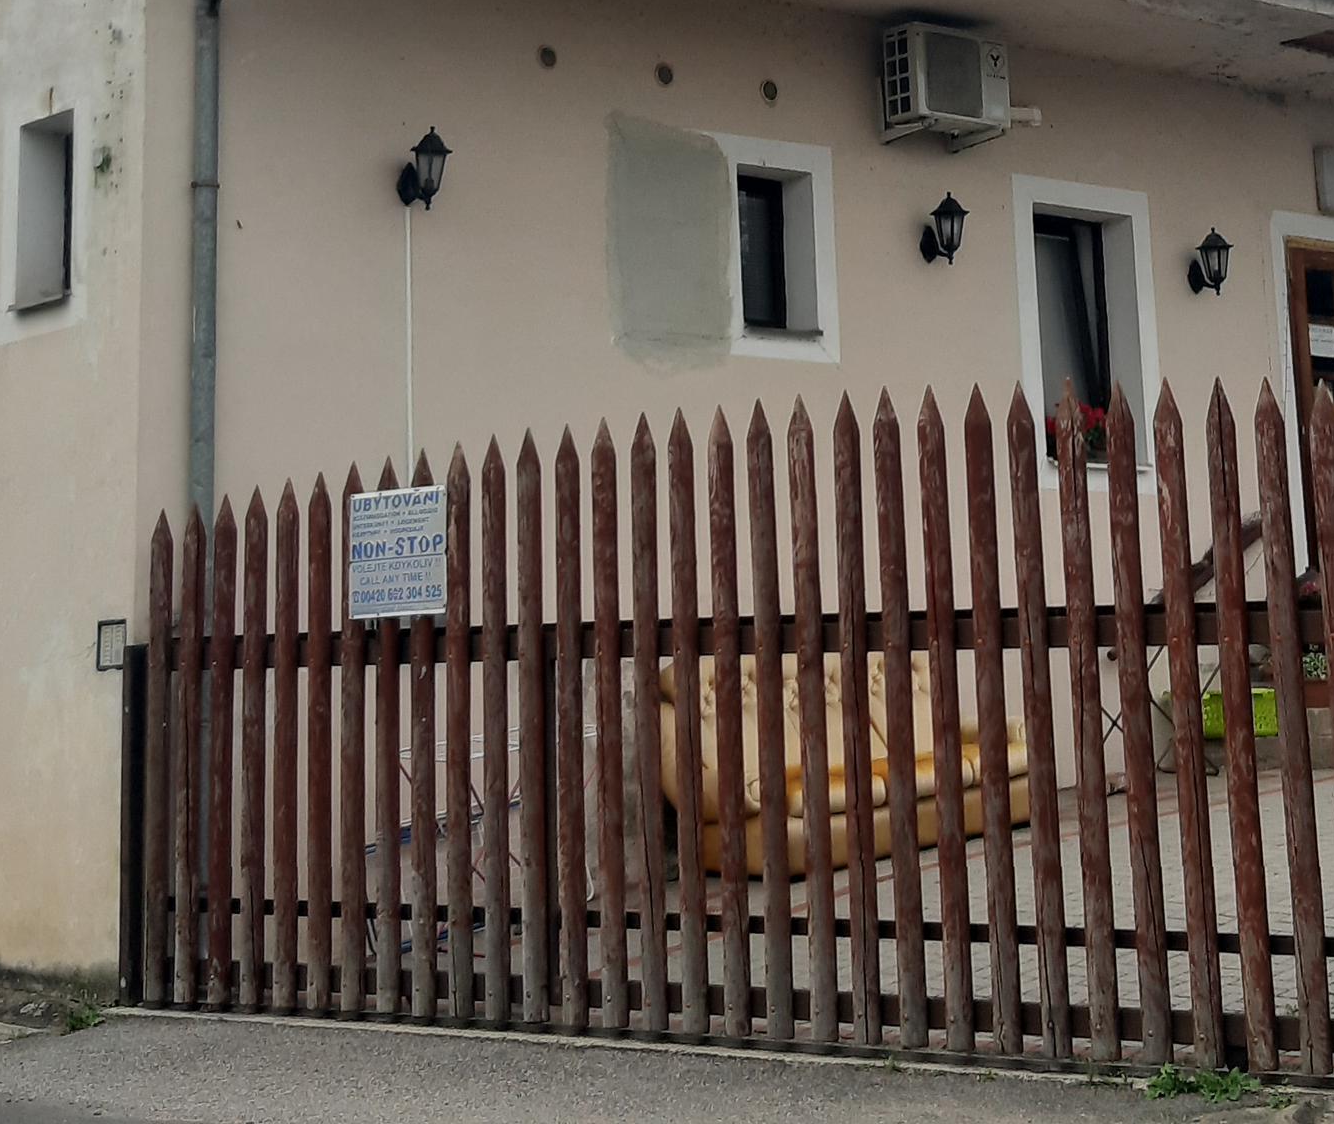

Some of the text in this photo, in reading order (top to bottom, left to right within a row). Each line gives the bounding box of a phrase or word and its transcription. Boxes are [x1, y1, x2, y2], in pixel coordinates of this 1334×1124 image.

[353, 487, 440, 512] UBYTOVÁNÍ
[352, 533, 444, 560] NON-STOP
[359, 576, 380, 586] CALL
[382, 573, 400, 584] ANY
[402, 571, 423, 582] TIME
[406, 586, 423, 600] 304
[425, 584, 442, 598] 525
